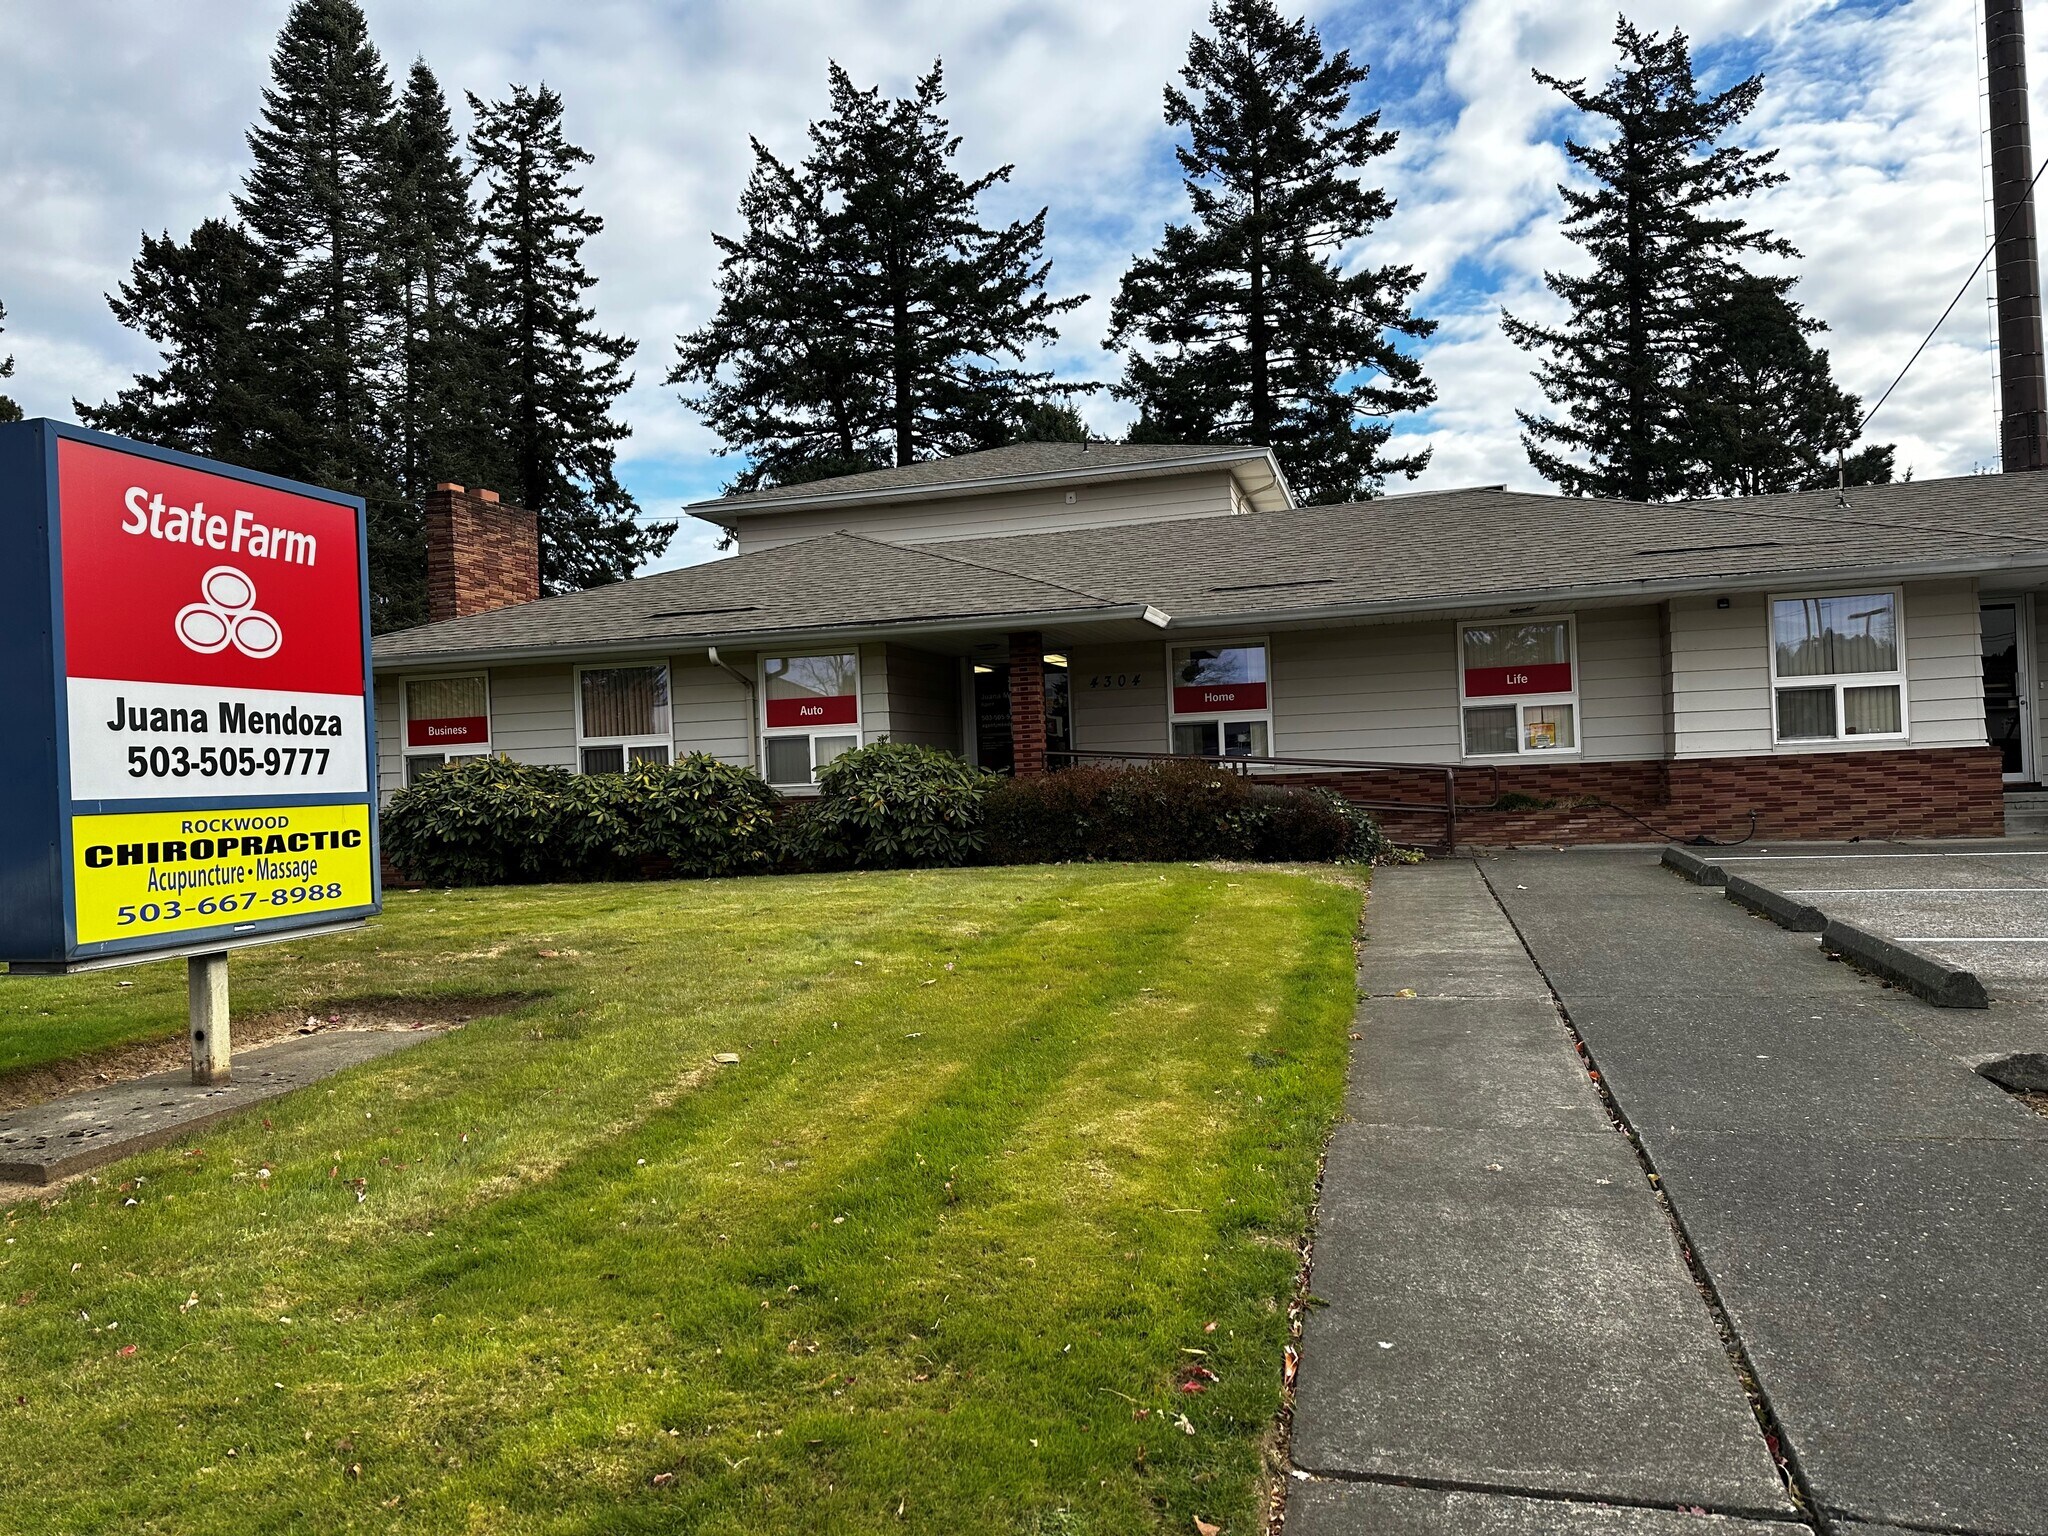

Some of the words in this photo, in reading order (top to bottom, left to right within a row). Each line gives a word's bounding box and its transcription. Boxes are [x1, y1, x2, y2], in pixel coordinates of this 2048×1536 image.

[1089, 673, 1141, 689] 4304
[1506, 673, 1528, 685] Life
[1204, 692, 1235, 702] Home
[106, 697, 209, 733] Juana
[218, 701, 343, 737] Mendoza
[800, 705, 823, 716] Auto
[428, 725, 468, 736] Business
[128, 746, 330, 778] 503-505-9777
[181, 816, 290, 834] ROCKWOOD
[84, 829, 362, 868] CHIROPRACTIC
[147, 864, 245, 896] Acupuncture
[256, 857, 318, 883] Massage
[116, 883, 343, 926] 503-667-8988
